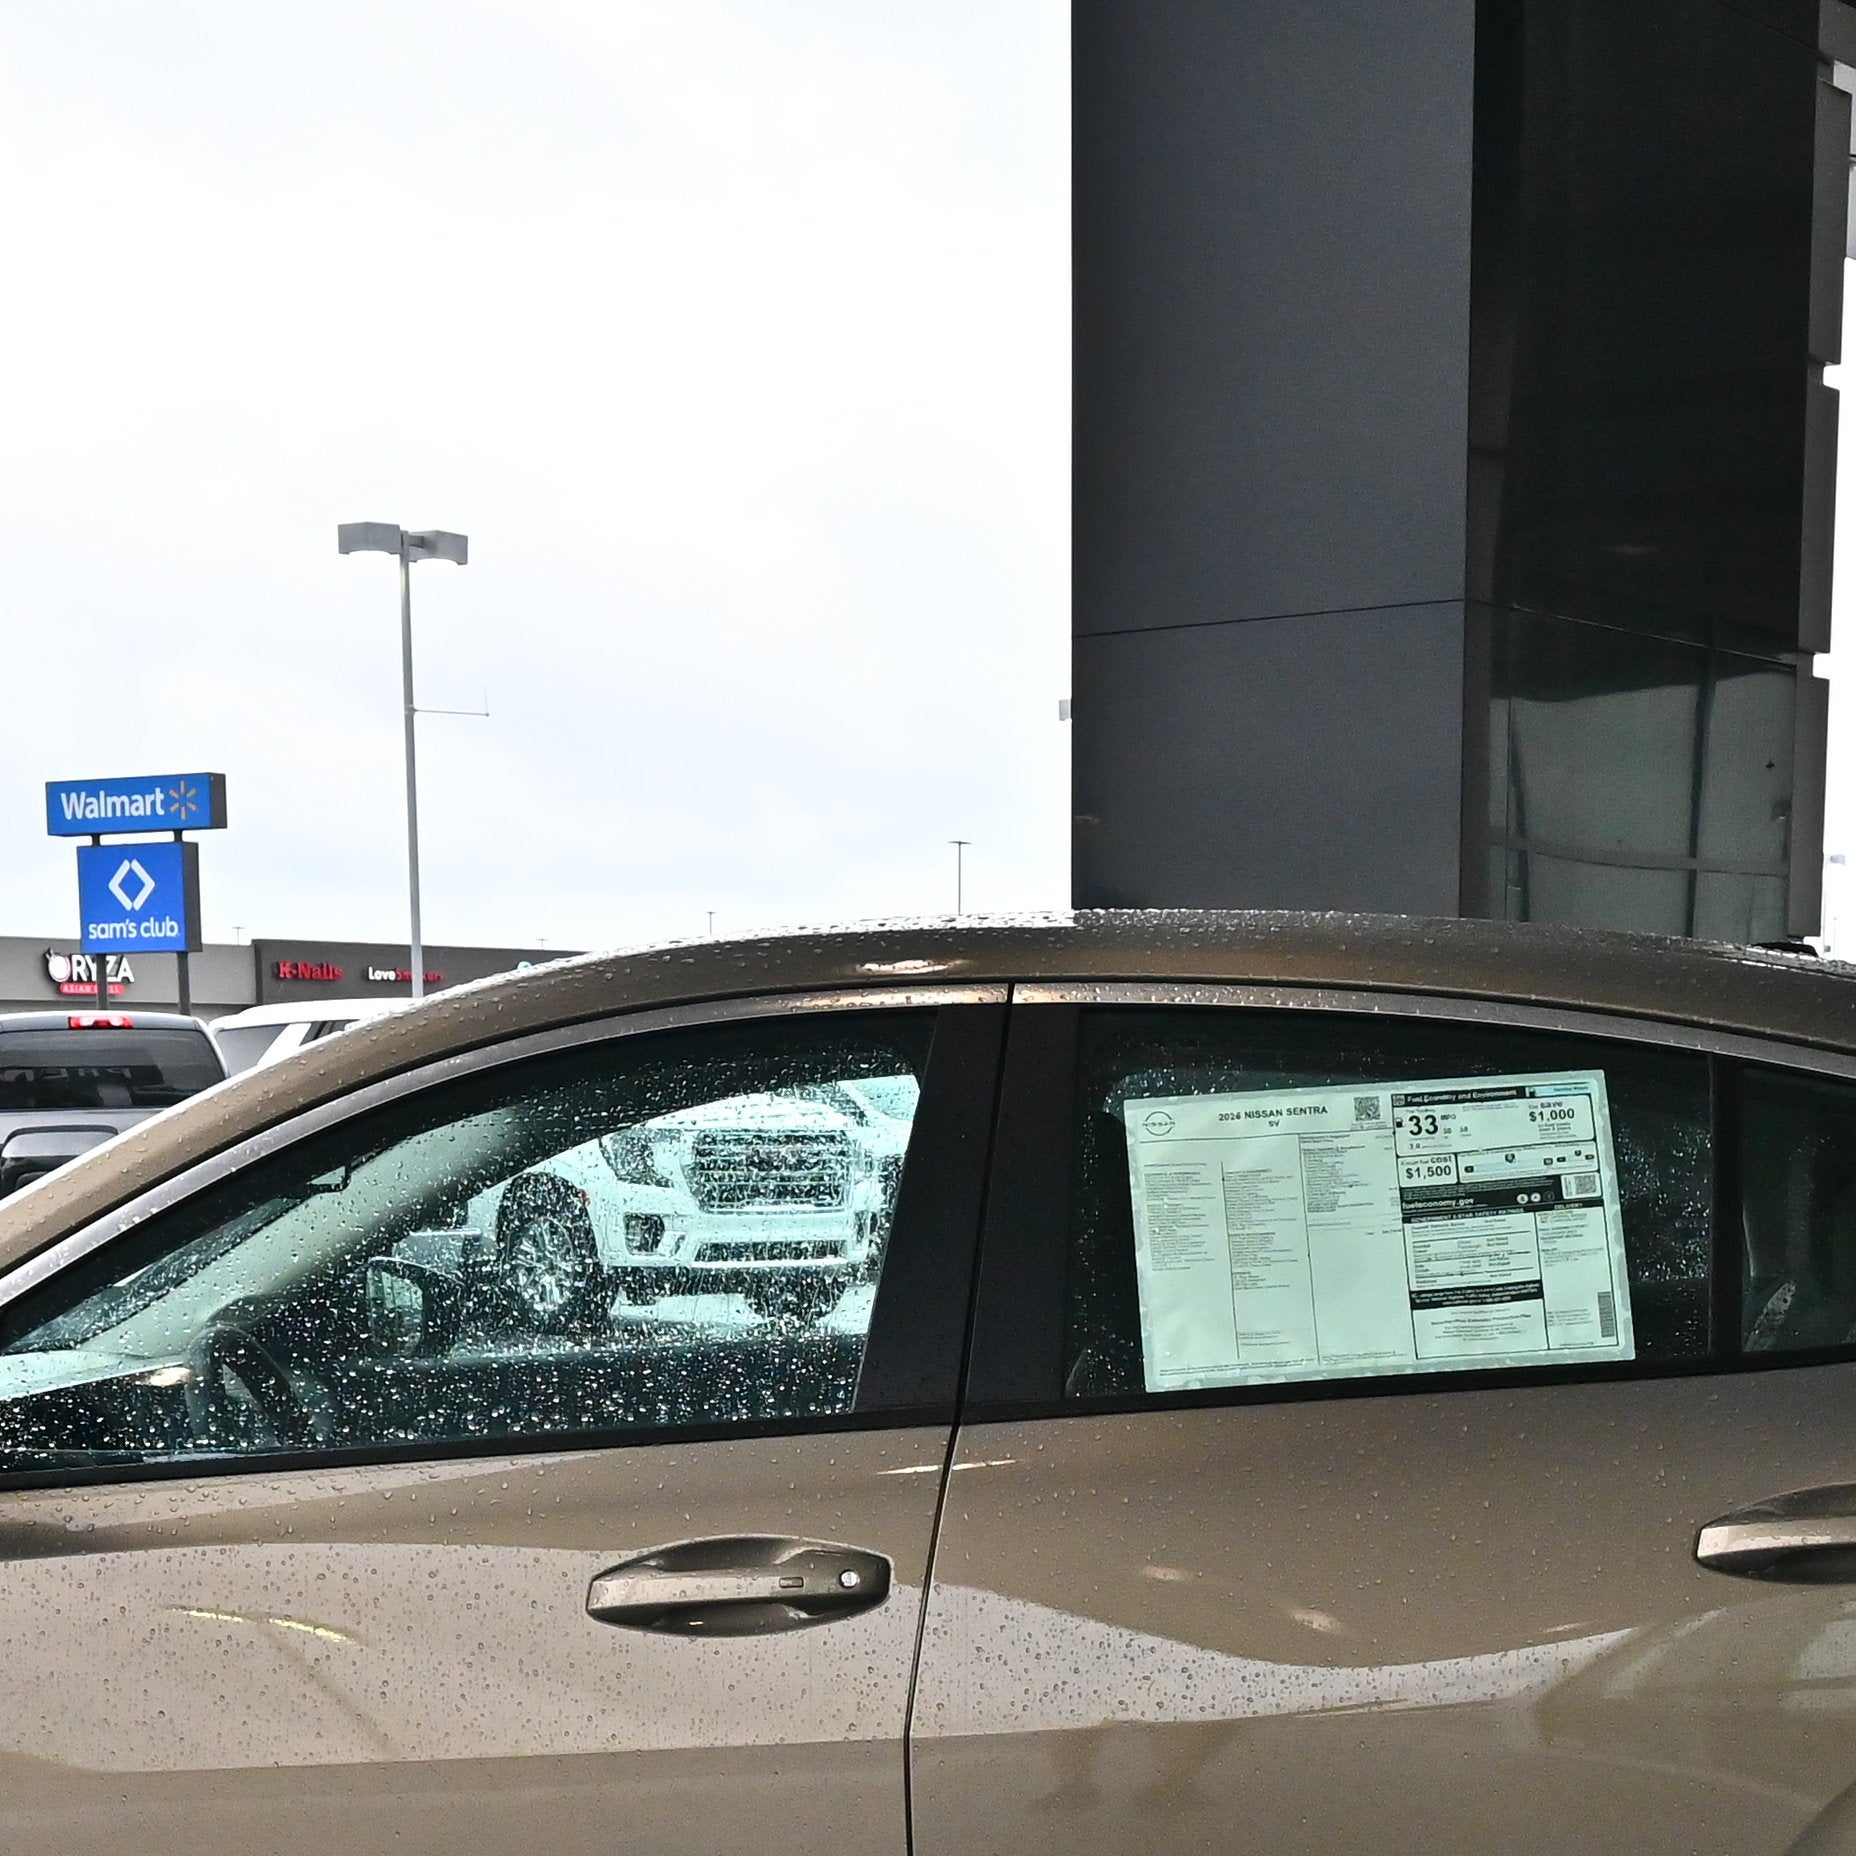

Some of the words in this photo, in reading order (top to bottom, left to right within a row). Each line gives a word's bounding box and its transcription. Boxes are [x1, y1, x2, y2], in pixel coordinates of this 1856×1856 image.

[60, 787, 165, 820] Walmart
[88, 918, 137, 939] sam's
[140, 915, 178, 938] club
[1219, 1111, 1242, 1122] 2026
[1244, 1108, 1283, 1119] NISSAN
[1286, 1105, 1328, 1116] SENTRA
[1529, 1108, 1575, 1122] $1,000
[1268, 1120, 1280, 1128] SV
[1408, 1114, 1439, 1136] 33
[1430, 1155, 1453, 1164] cost
[1406, 1165, 1451, 1181] $1,500
[1402, 1198, 1474, 1210] fueleconomy.gov
